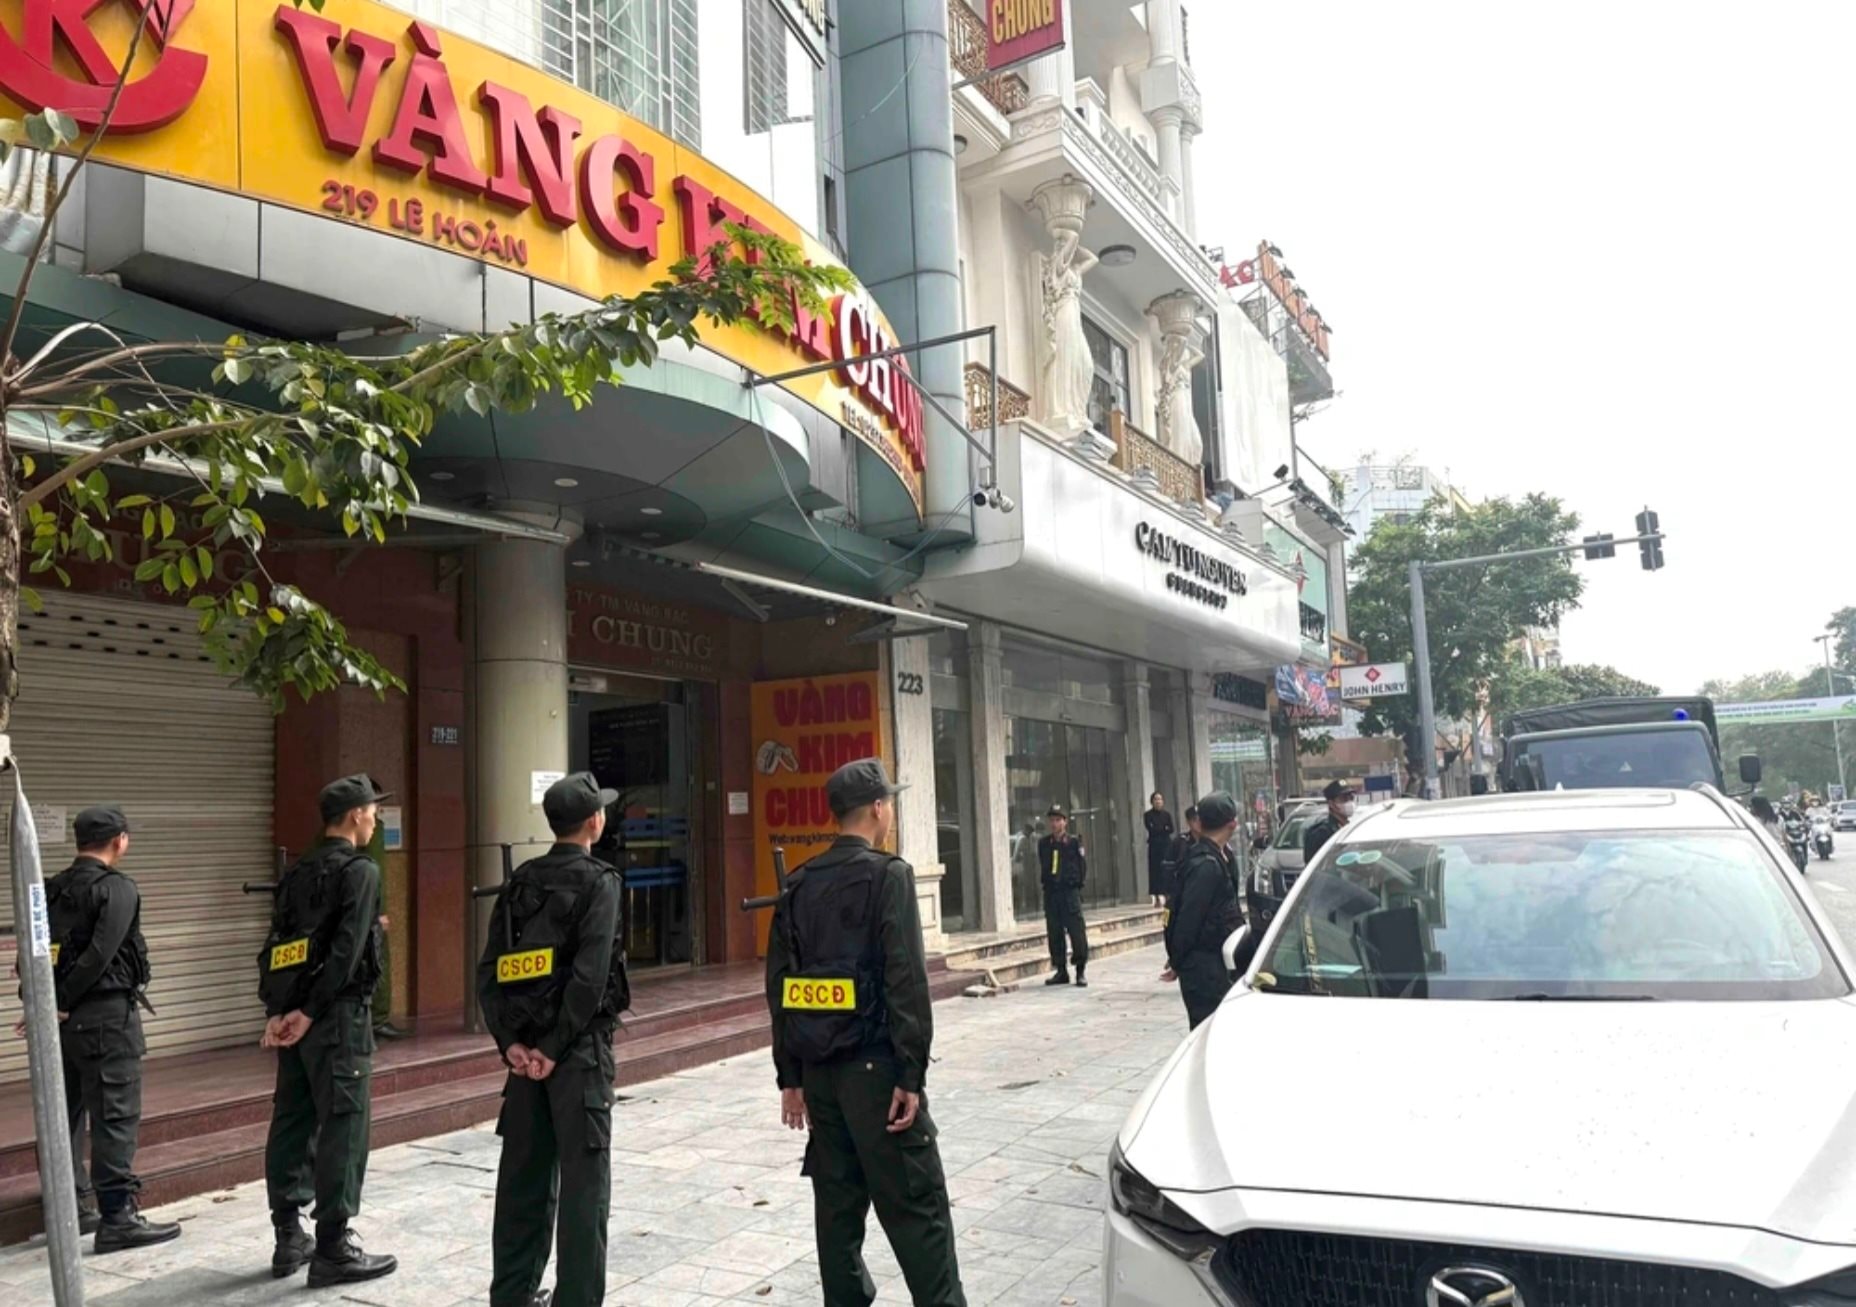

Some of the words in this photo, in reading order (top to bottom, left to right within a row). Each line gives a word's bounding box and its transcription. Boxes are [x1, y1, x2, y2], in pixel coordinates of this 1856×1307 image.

[274, 4, 664, 263] VÀNG
[322, 180, 379, 219] 219
[389, 197, 424, 235] LÊ
[432, 219, 528, 267] HOÀN
[592, 615, 715, 660] CHUNG
[773, 679, 872, 727] VÀNG
[898, 671, 924, 696] 223
[1343, 686, 1369, 698] JOHN
[1370, 682, 1406, 694] HENRY
[765, 786, 837, 828] CHU
[500, 955, 546, 977] CSCĐ
[789, 983, 845, 1003] CSCĐ
